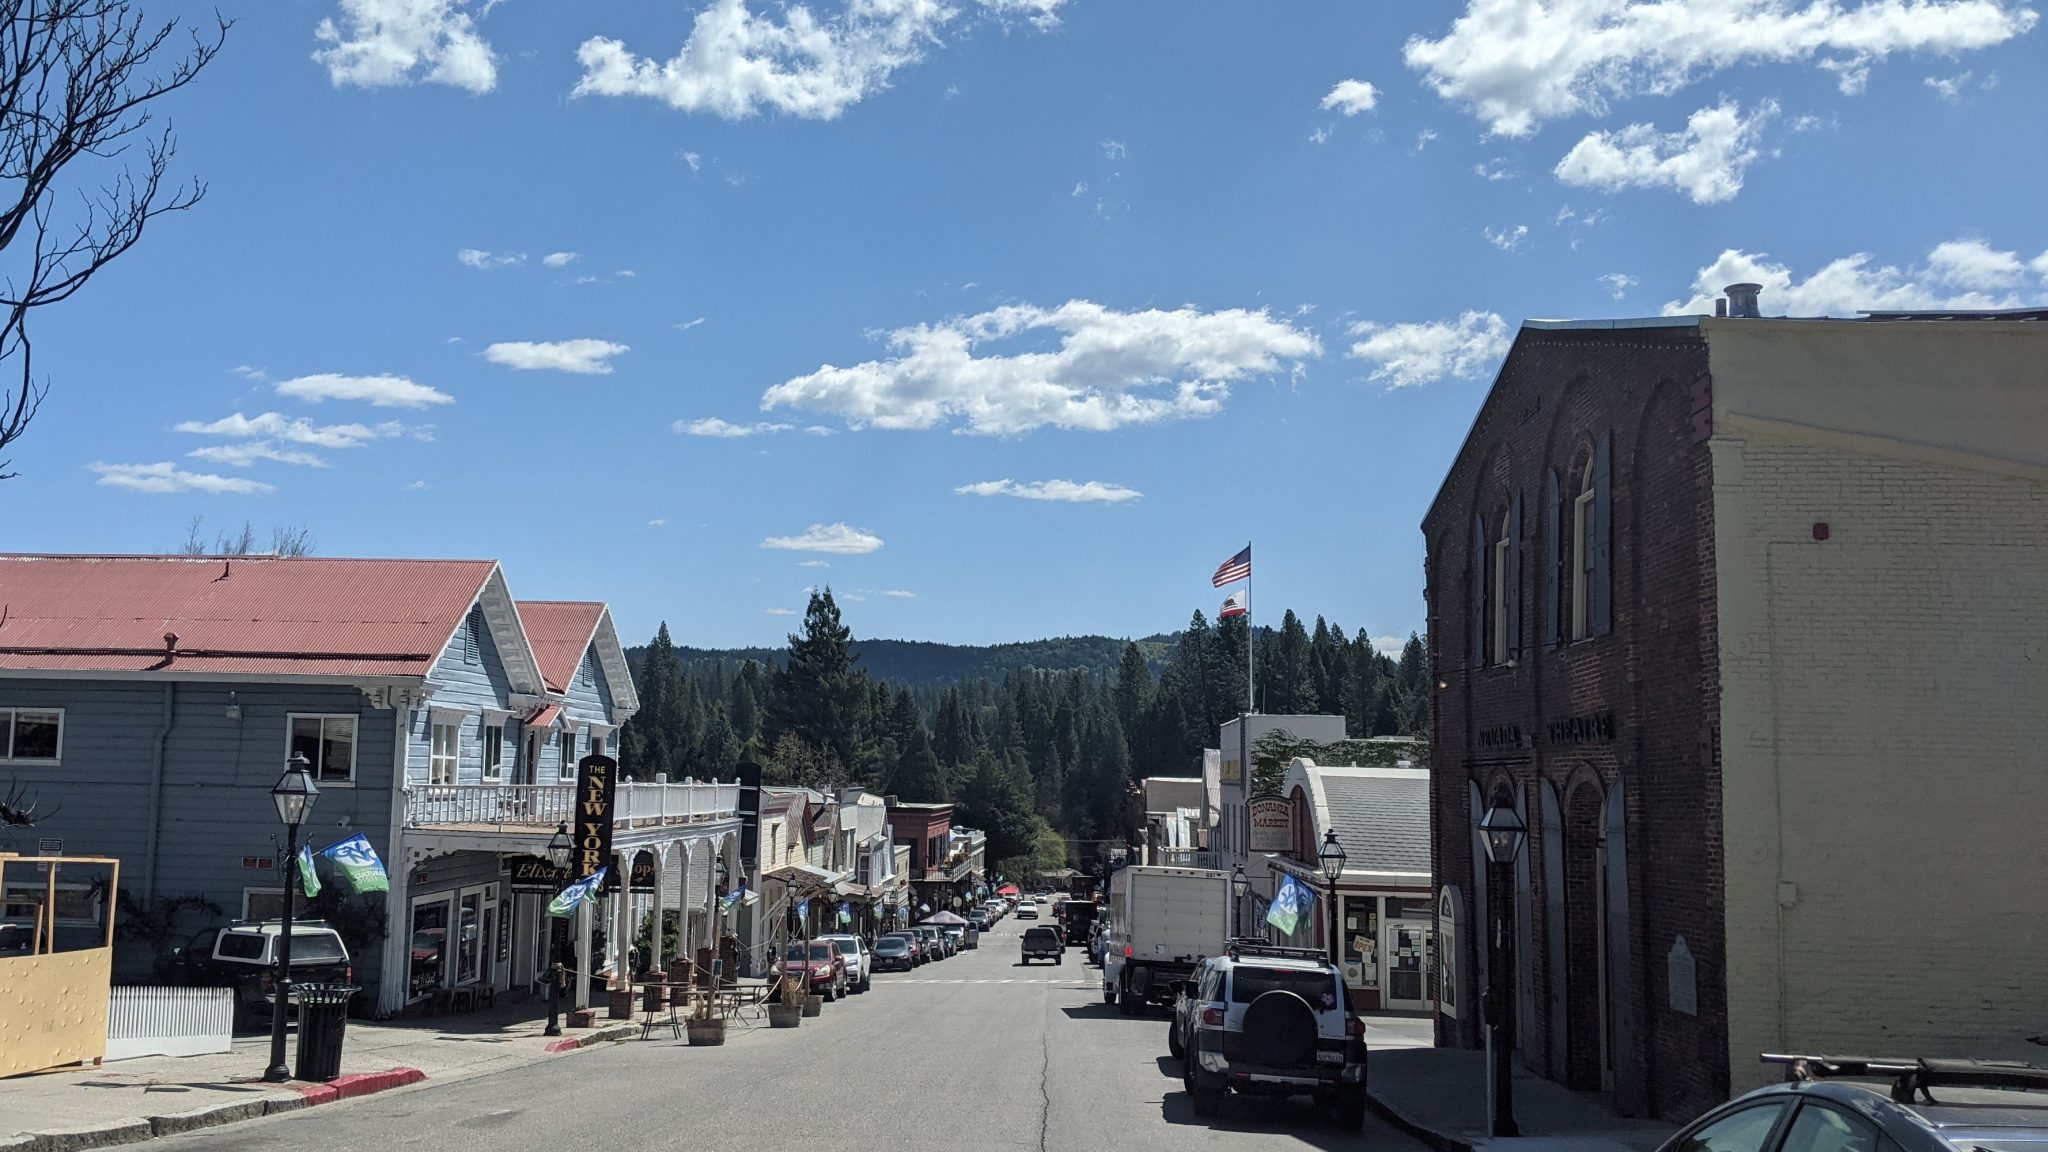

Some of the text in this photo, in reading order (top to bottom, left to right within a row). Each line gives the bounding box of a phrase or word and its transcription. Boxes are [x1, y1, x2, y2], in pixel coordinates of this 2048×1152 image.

[1547, 715, 1612, 744] THEATRE
[589, 765, 606, 774] THE
[583, 775, 608, 816] NEW
[1252, 802, 1289, 817] BONANZA
[1253, 818, 1289, 828] MARKET
[581, 822, 604, 876] YORK
[1354, 941, 1373, 952] OPEN
